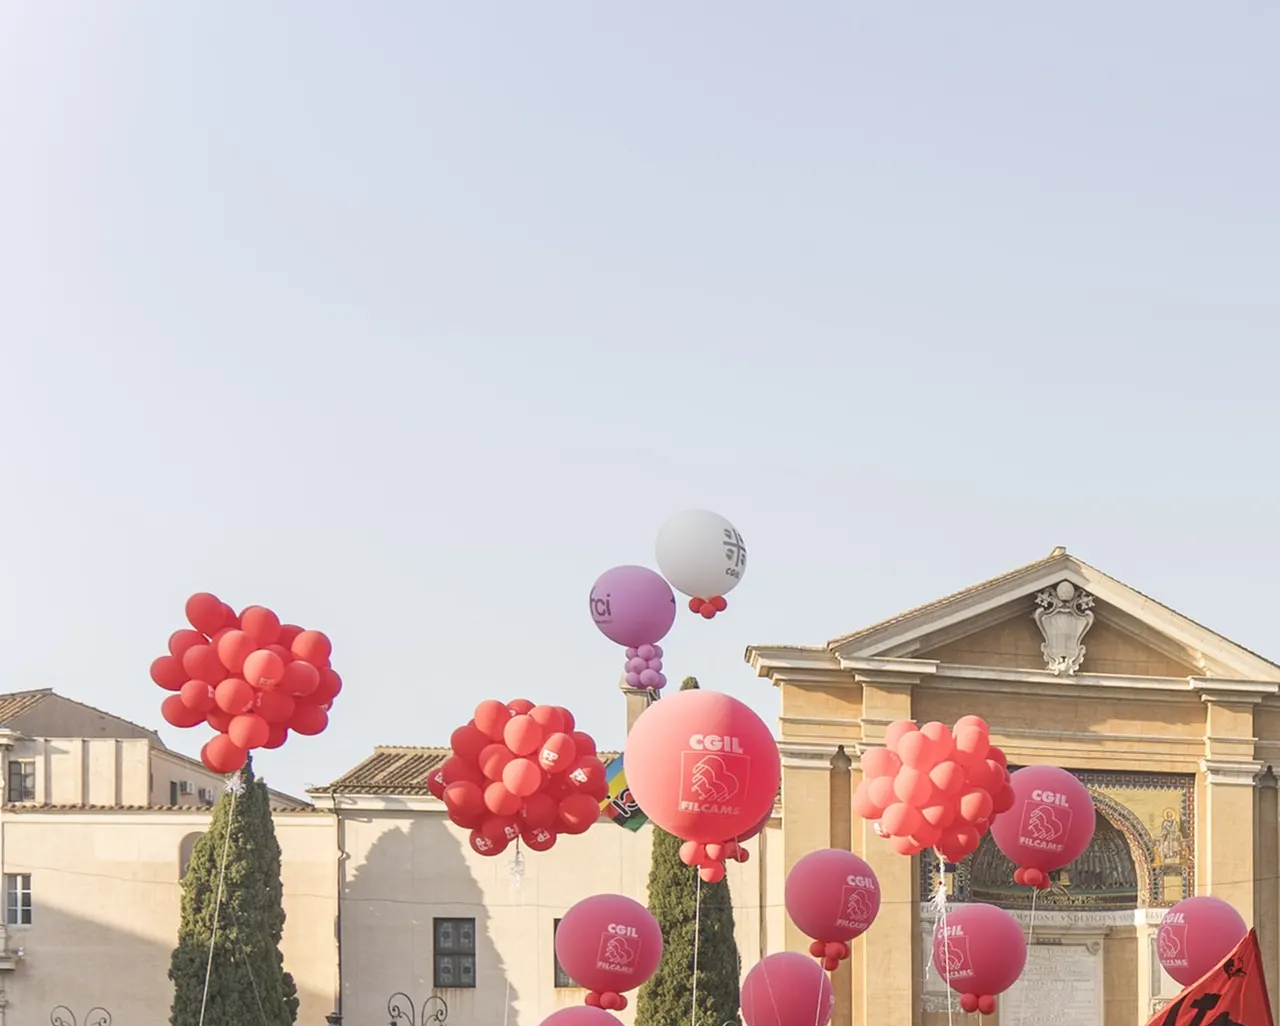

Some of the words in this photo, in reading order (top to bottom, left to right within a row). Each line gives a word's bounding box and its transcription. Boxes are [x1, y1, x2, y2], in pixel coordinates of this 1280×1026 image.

[689, 733, 744, 754] CGIL
[1032, 789, 1069, 807] CGIL
[680, 800, 741, 815] FILCAMS
[1019, 837, 1064, 851] FILCAMS
[847, 875, 875, 890] CGIL
[1163, 912, 1185, 924] CGIL
[607, 923, 638, 938] CGIL
[598, 961, 634, 974] FILCAMS
